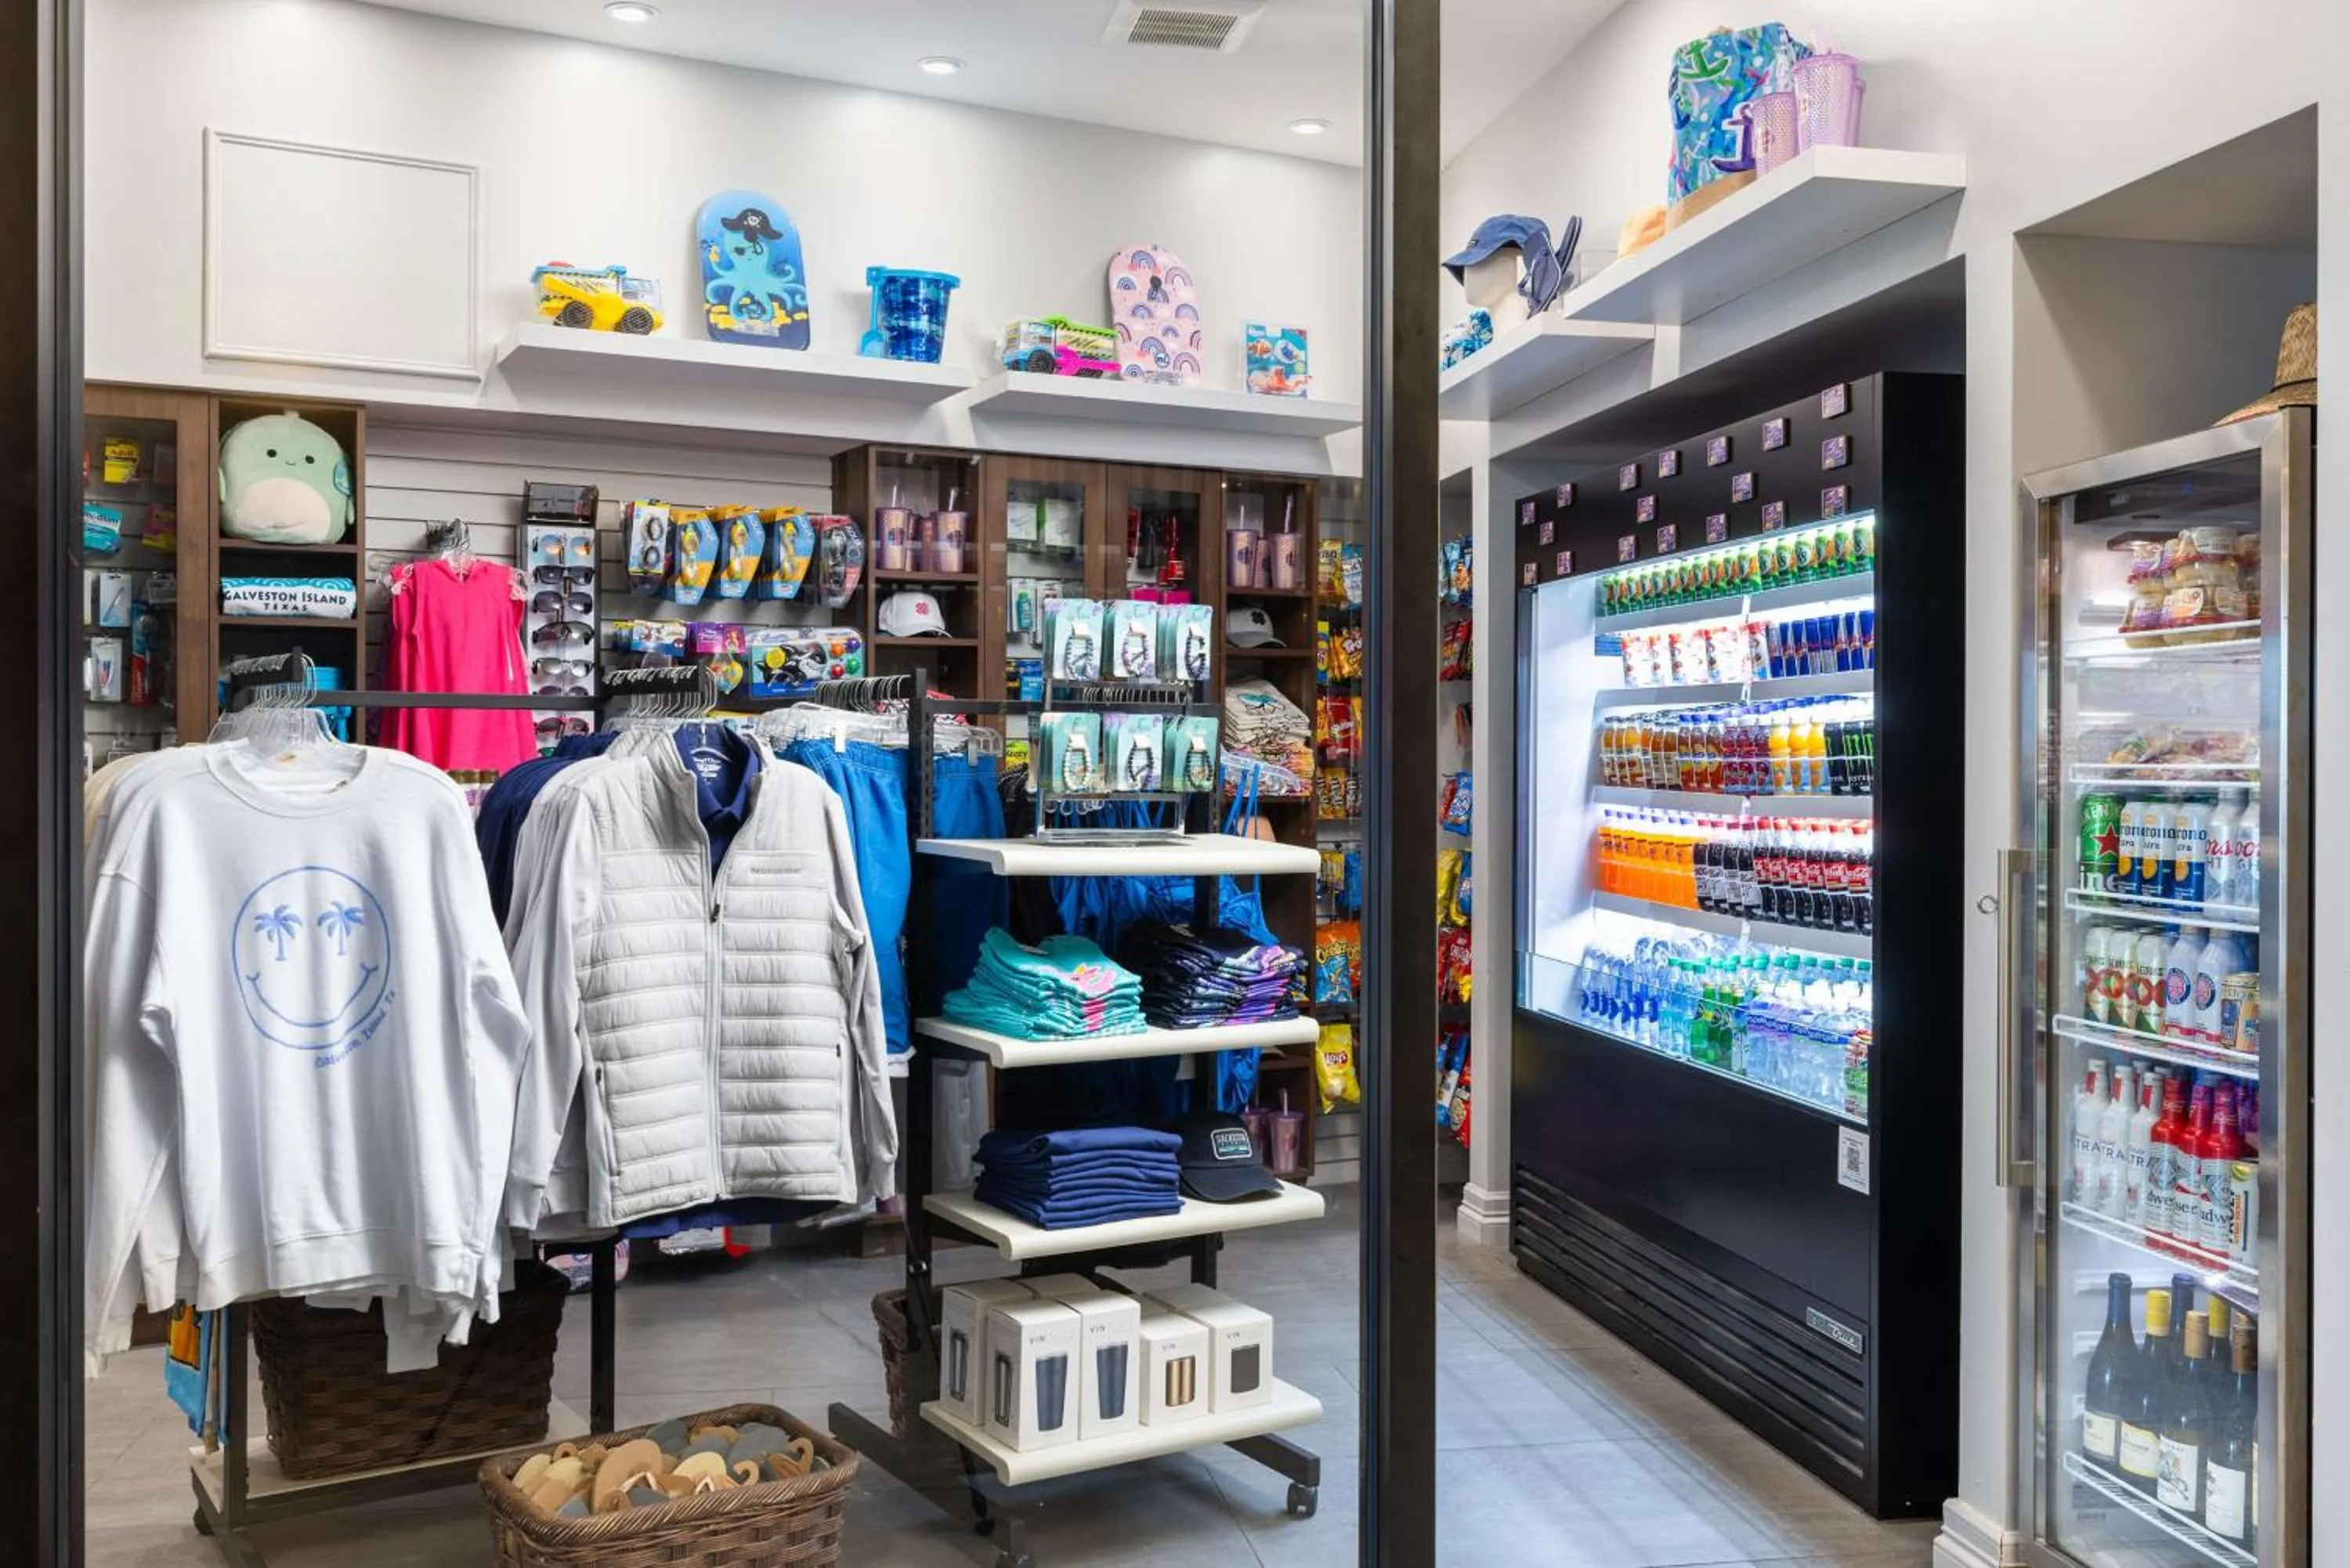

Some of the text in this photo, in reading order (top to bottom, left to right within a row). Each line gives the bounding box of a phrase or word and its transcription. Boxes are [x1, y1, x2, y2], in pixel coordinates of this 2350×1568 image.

[225, 591, 347, 605] GALVESTON ISLAND
[263, 602, 308, 612] TEXAS
